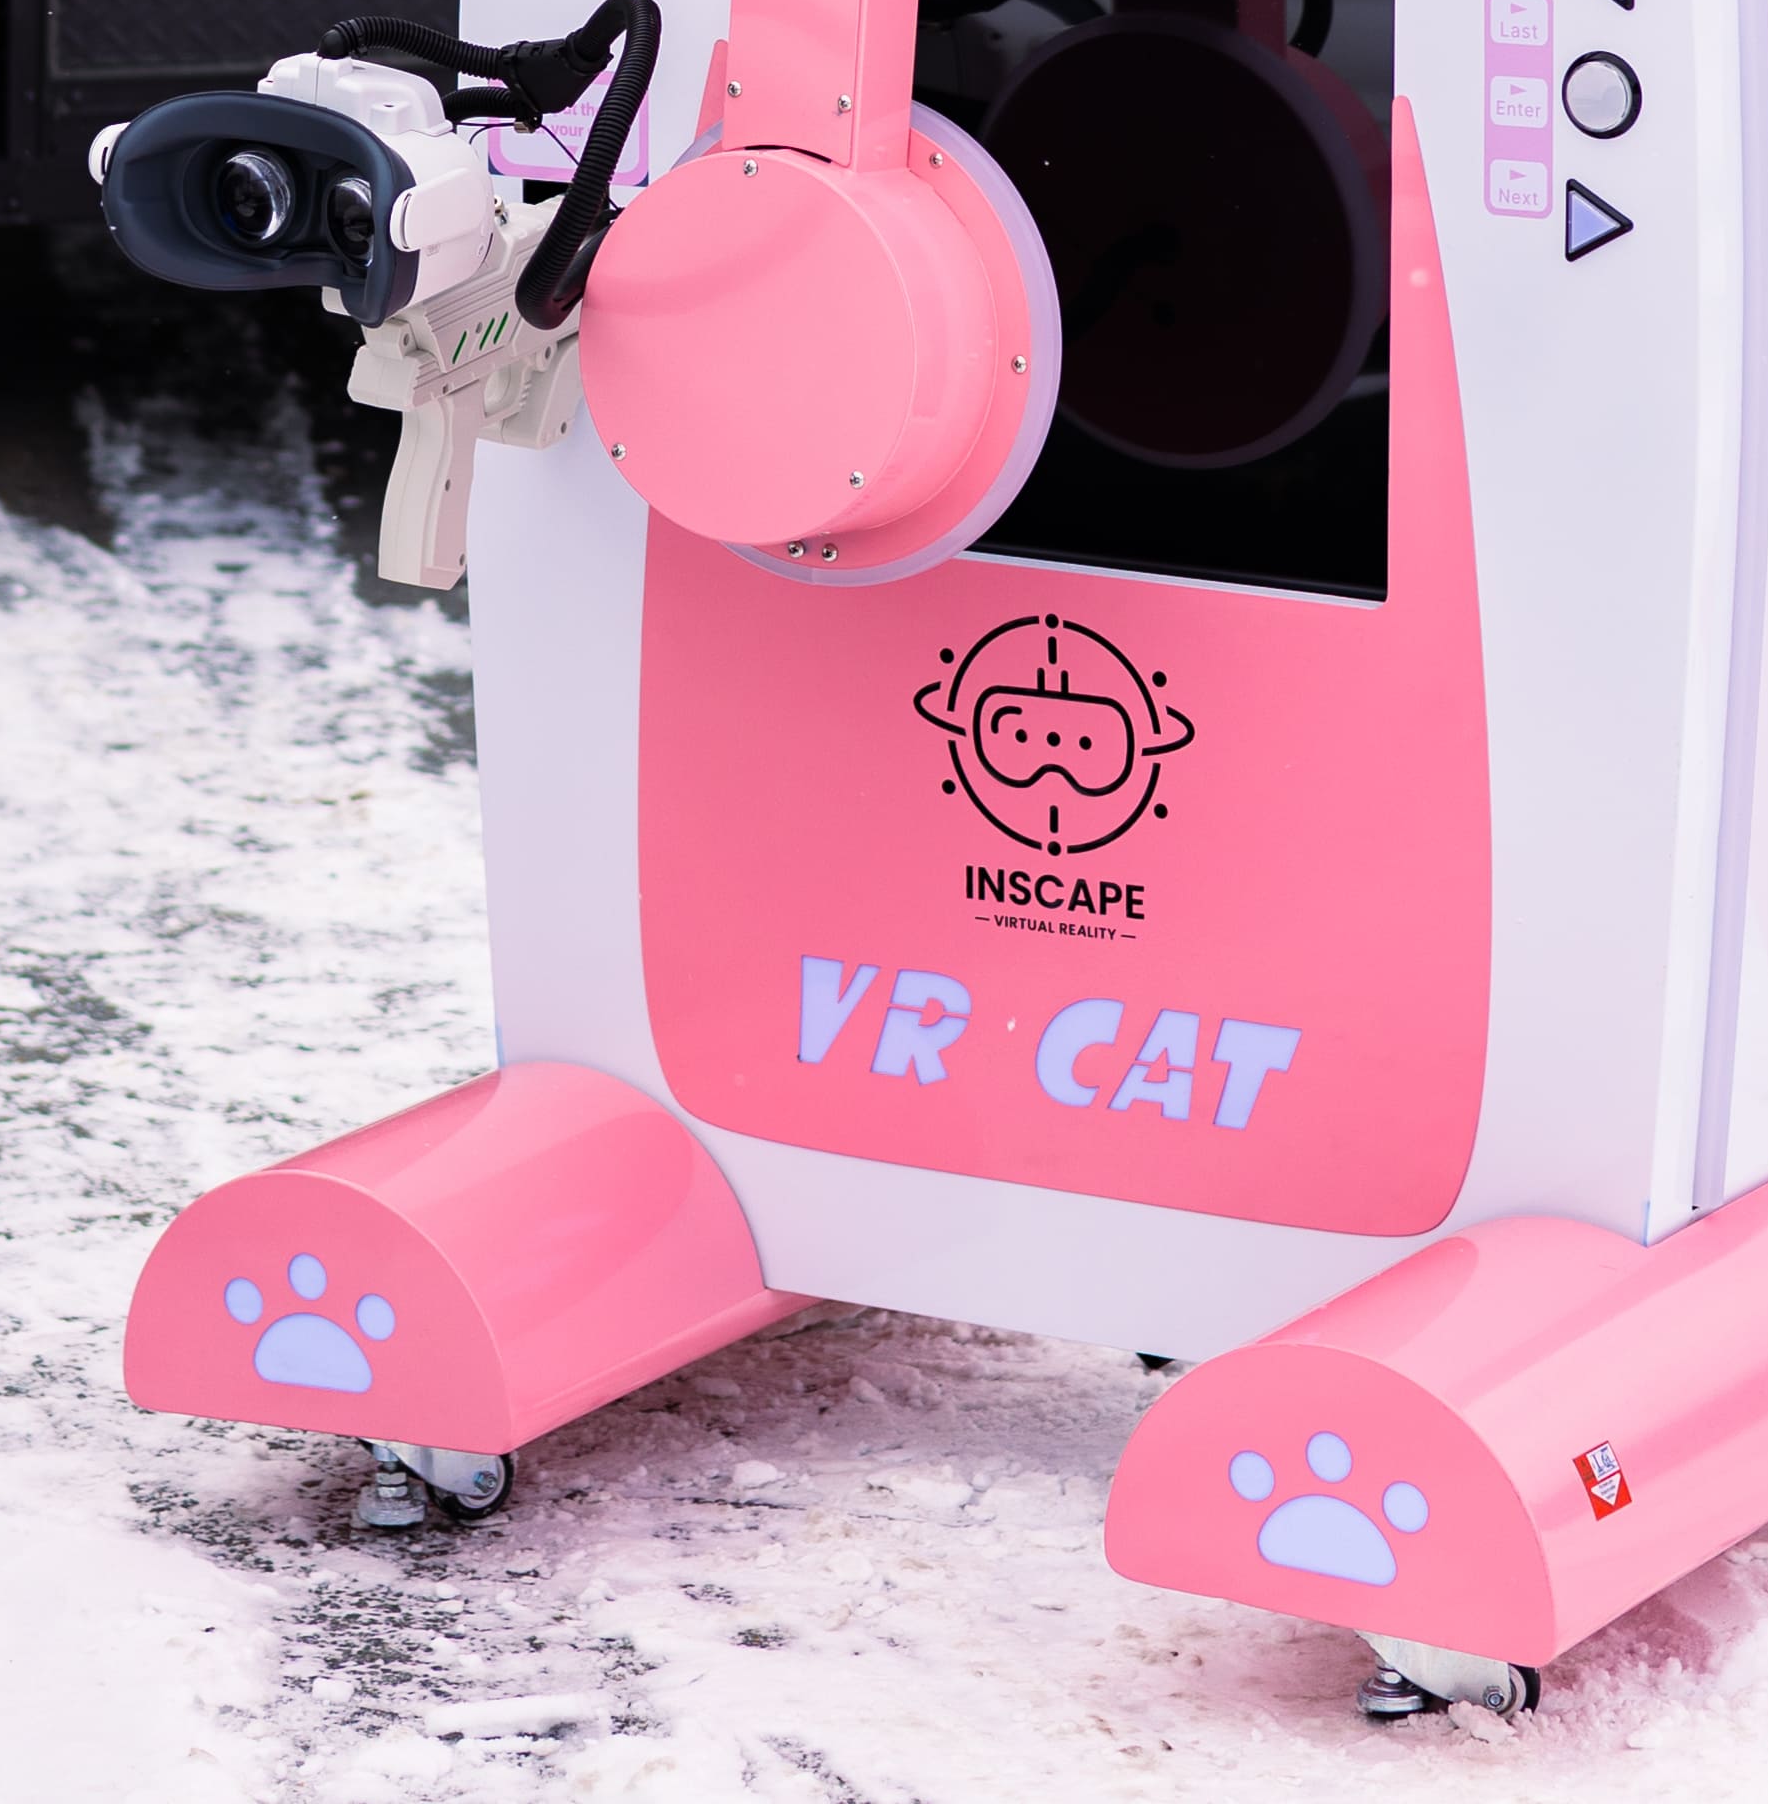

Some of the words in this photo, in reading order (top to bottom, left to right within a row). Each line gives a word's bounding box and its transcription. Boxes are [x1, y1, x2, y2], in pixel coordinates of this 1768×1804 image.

[1500, 21, 1539, 40] Last
[1496, 100, 1542, 118] Enter
[551, 125, 584, 137] your
[1498, 188, 1539, 206] Next
[966, 865, 1145, 920] INSCAPE
[994, 914, 1055, 934] VIRTUAL
[1059, 922, 1116, 941] REALITY
[798, 955, 972, 1086] VR
[1034, 998, 1302, 1131] CAT
